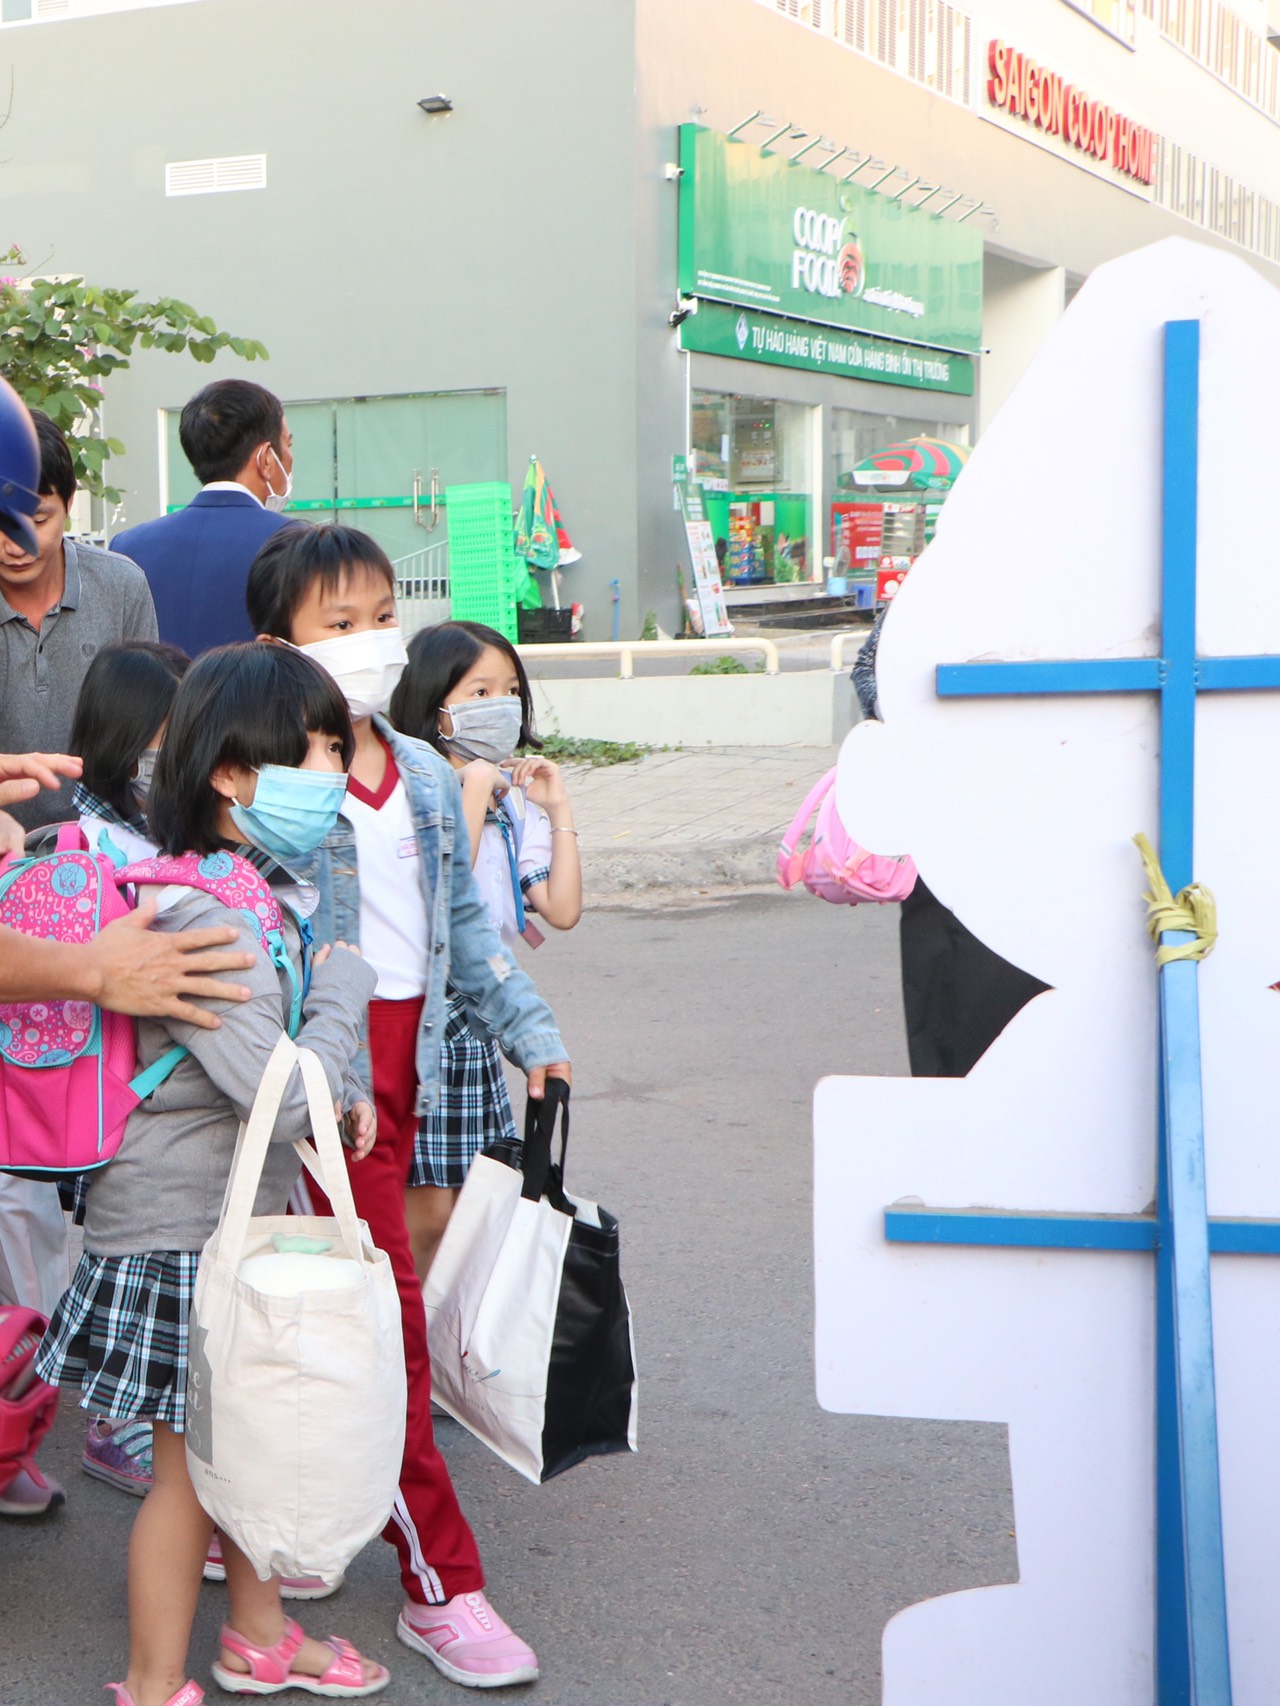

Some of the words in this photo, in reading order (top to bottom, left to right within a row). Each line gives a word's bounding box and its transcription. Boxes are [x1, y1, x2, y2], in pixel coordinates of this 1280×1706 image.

[987, 38, 1063, 136] SAIGON
[1113, 113, 1159, 186] HOME
[785, 329, 809, 358] HÀNG
[810, 335, 827, 365] VIỆT
[828, 341, 847, 364] NAM
